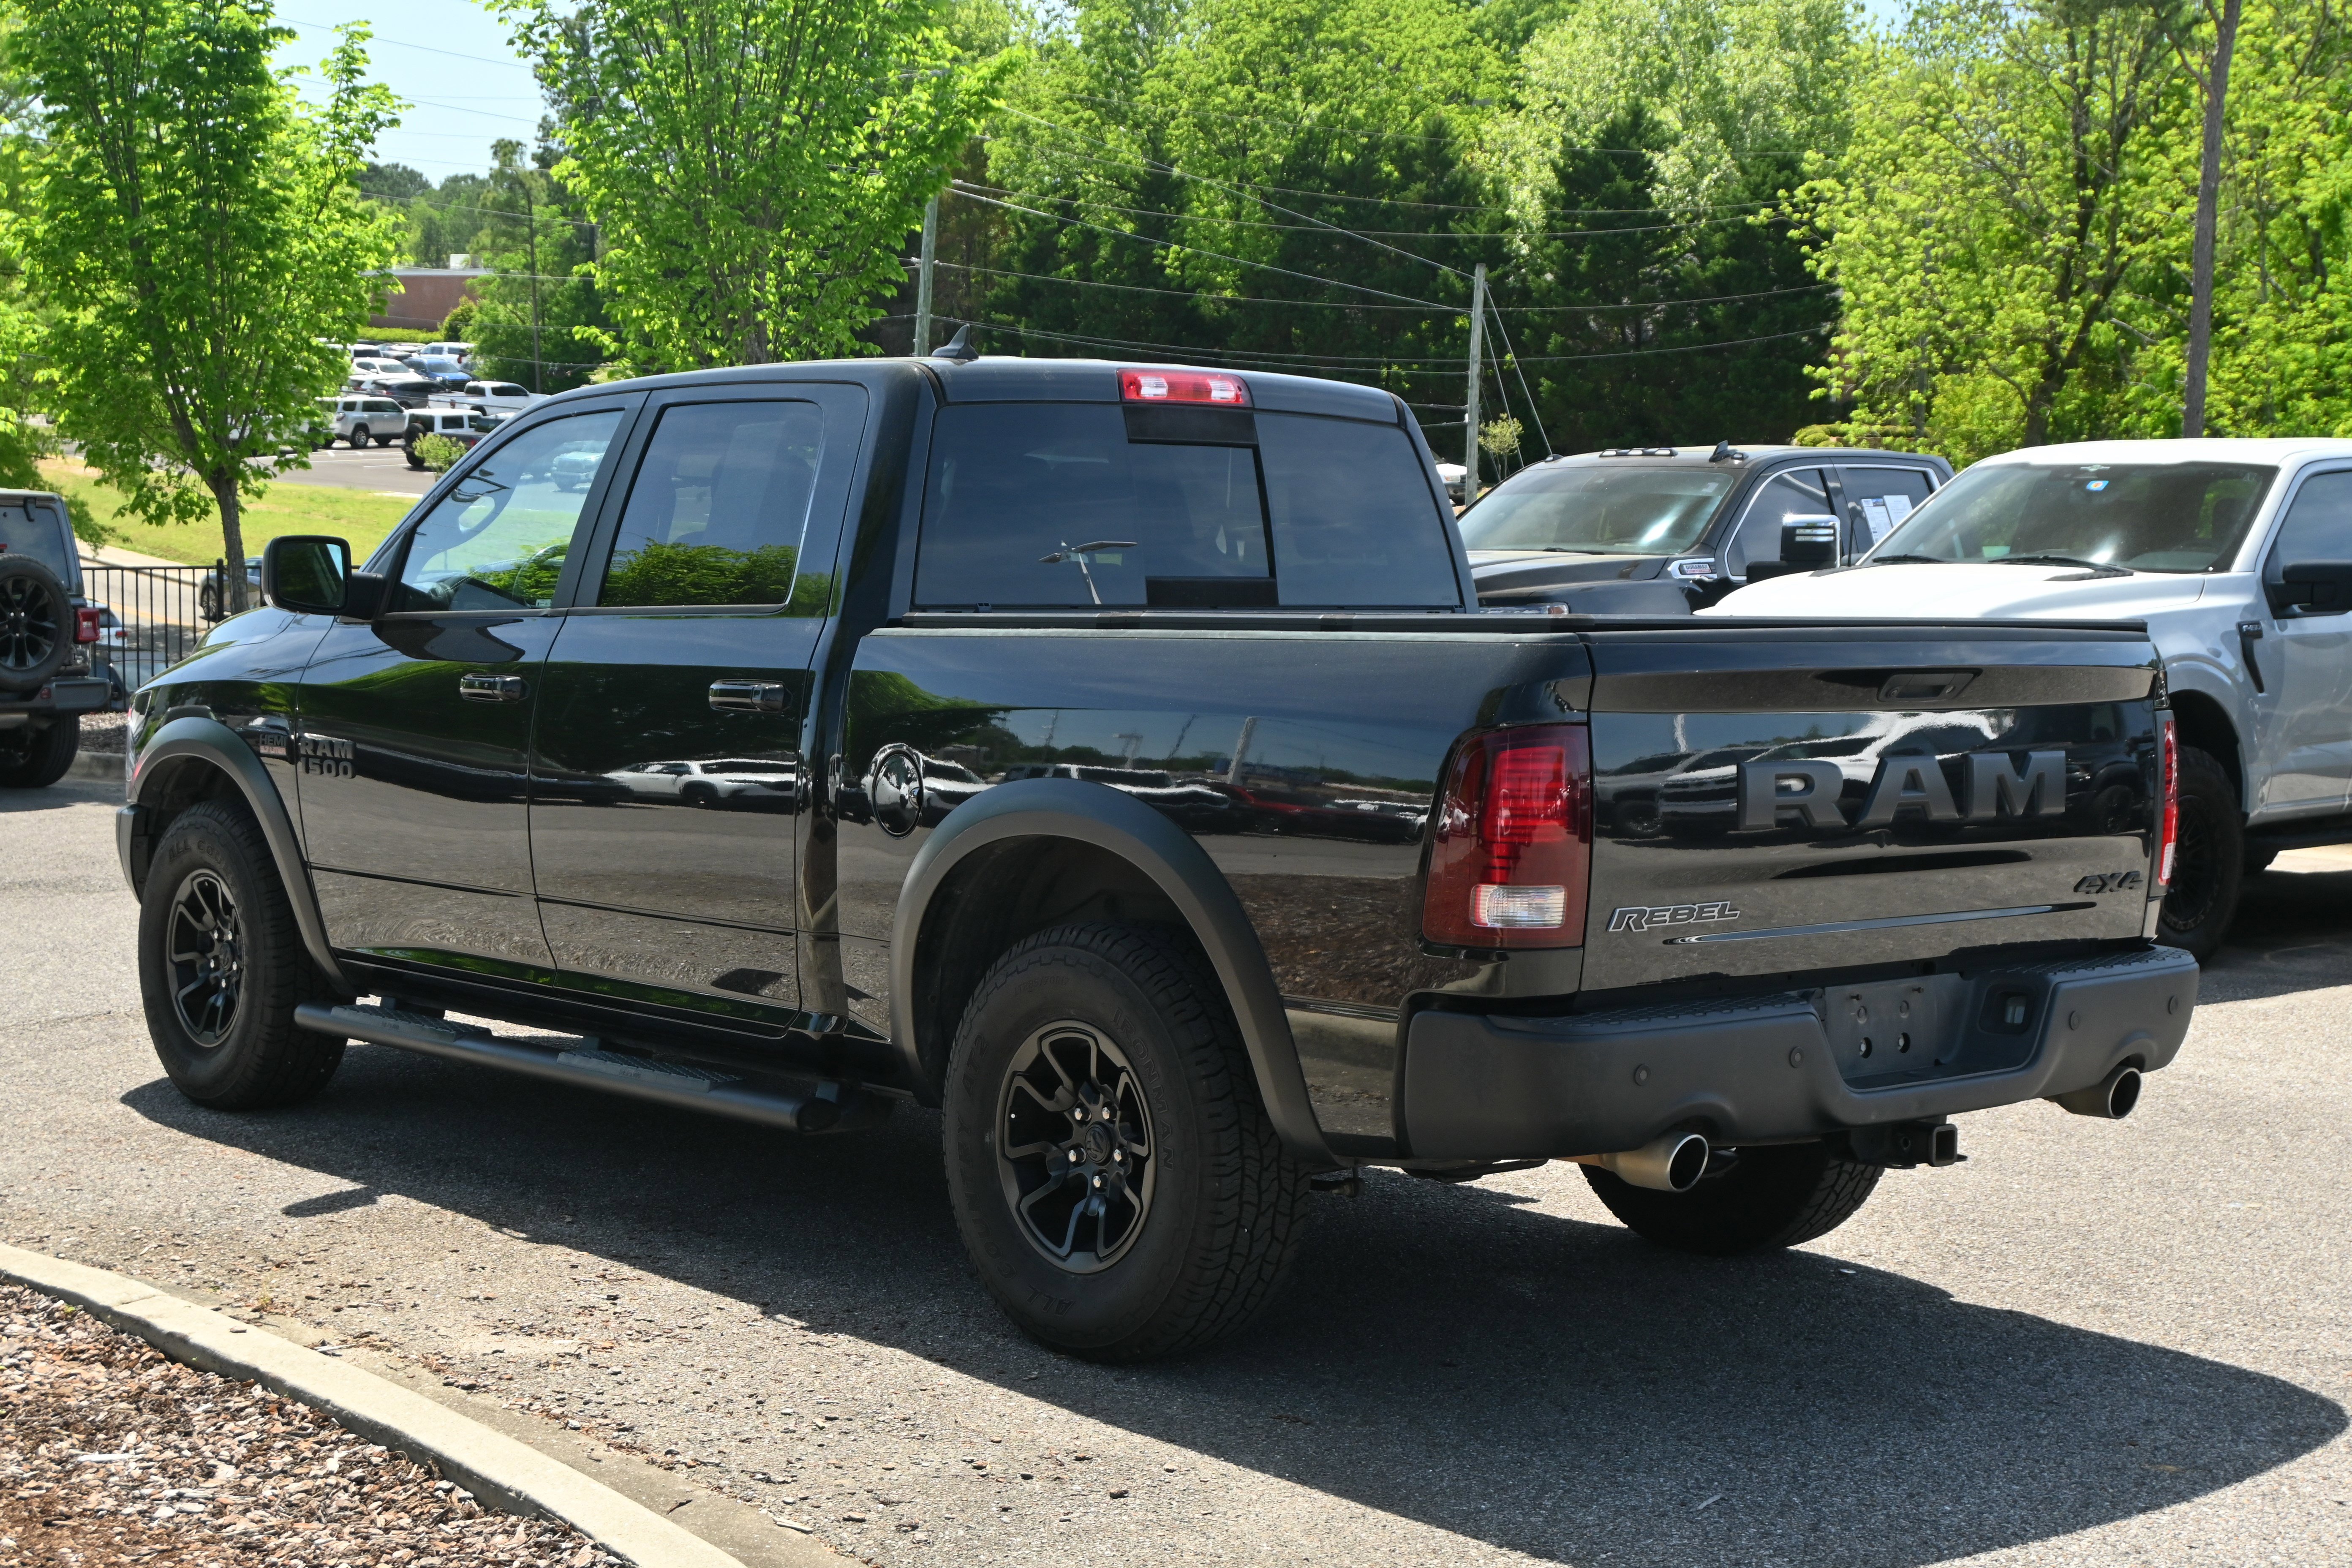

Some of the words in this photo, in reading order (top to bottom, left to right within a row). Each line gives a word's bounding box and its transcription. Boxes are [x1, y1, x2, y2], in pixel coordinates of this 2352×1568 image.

[259, 734, 287, 746] HEMI
[299, 738, 356, 759] RAM
[297, 757, 356, 779] 1500
[1737, 750, 2066, 831] RAM
[2073, 871, 2143, 894] 4X4
[1606, 901, 1740, 932] REBEL
[961, 1032, 990, 1097] AT2
[1111, 1006, 1174, 1171] IRONMAN
[957, 1111, 1016, 1280] COUNTRY
[1025, 1285, 1075, 1317] ALL
